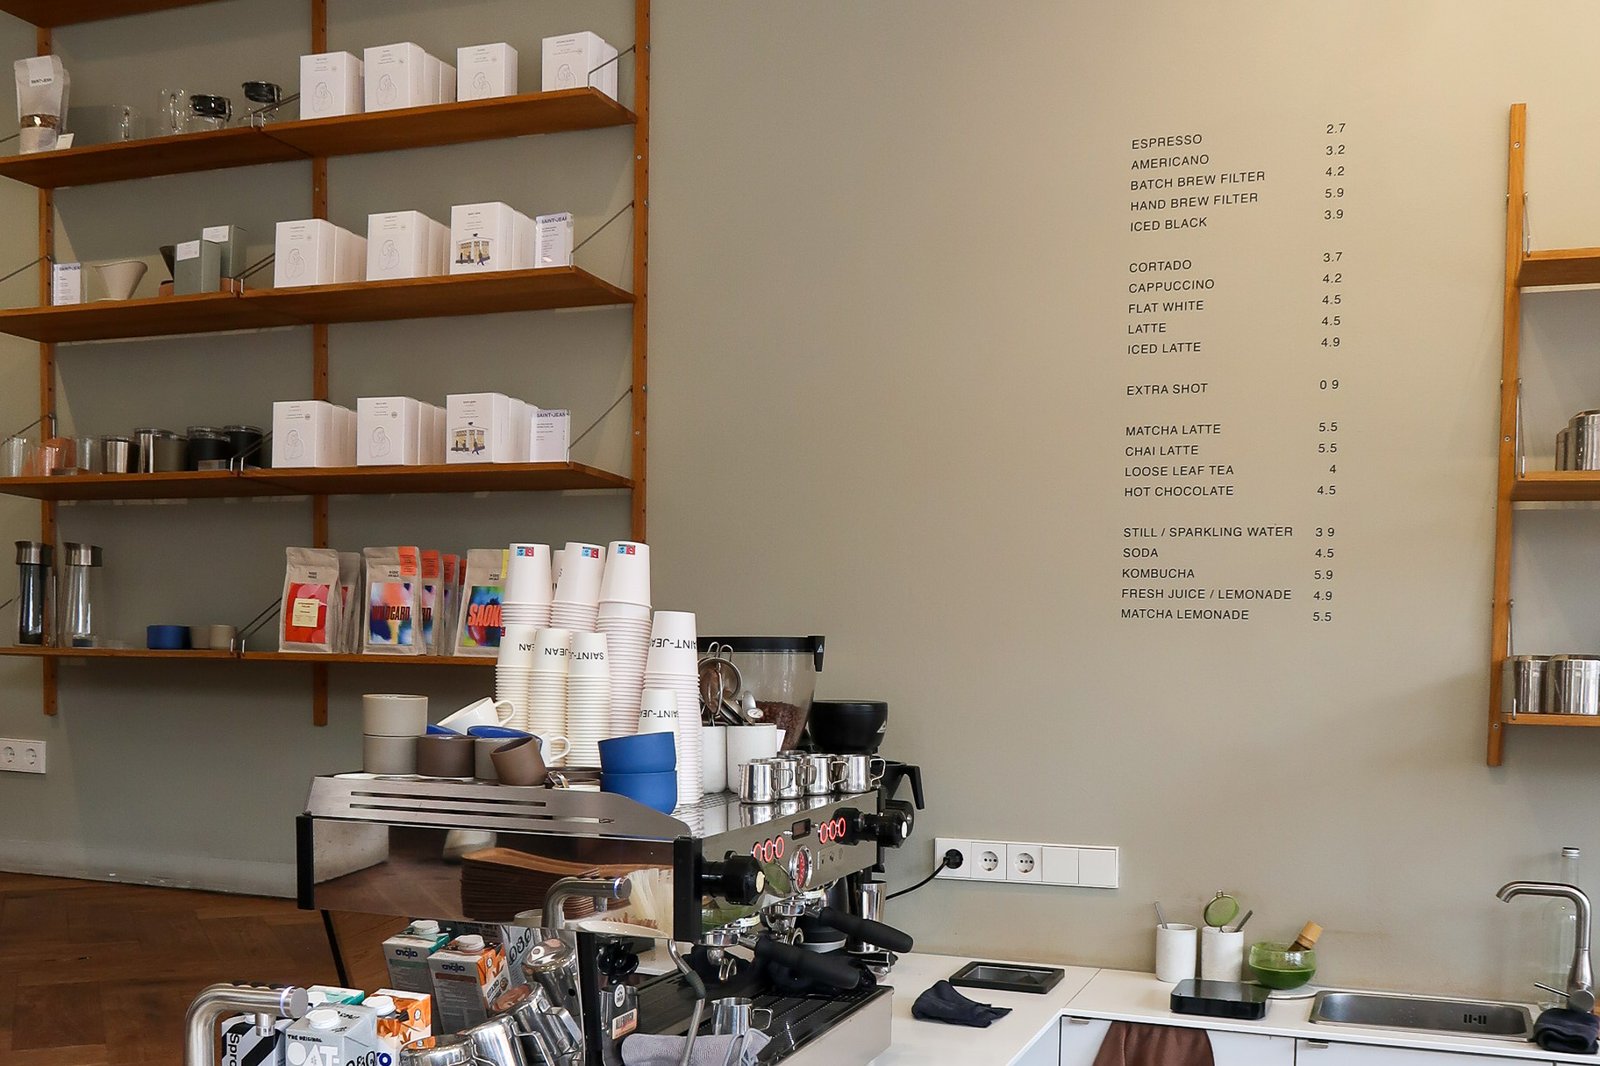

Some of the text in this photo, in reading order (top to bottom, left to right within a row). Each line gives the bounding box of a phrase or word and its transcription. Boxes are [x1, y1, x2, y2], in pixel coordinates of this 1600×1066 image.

[1131, 122, 1347, 150] ESPRESSO 2.7
[1130, 144, 1346, 171] AMERICANO 3.2
[1130, 165, 1345, 191] BATCH BREW FILTER 4.2
[1130, 187, 1345, 212] HAND BREW FILTER 5.9
[1130, 208, 1344, 233] ICED BLACK 3.9
[1129, 251, 1343, 274] CORTADO 3.7
[1128, 272, 1343, 294] CAPPUCCINO 4.2
[1128, 294, 1342, 314] FLAT WHITE 4.5
[1127, 315, 1341, 335] LATTE 4.5
[1127, 336, 1341, 355] ICED LATTE 4.9
[1126, 384, 1169, 396] EXTRA
[1172, 382, 1209, 395] SHOT
[1125, 421, 1338, 437] MATCHA LATTE 5.5
[1124, 442, 1338, 457] CHAI LATTE 5.5
[1124, 464, 1337, 477] LOOSE LEAF TEA 4
[1124, 485, 1337, 498] HOT CHOCOLATE 4.5
[1123, 527, 1158, 538] STILL
[1168, 526, 1243, 538] SPARKLING
[1246, 526, 1293, 537] WATER
[1122, 547, 1335, 559] SODA 4.5
[1122, 568, 1334, 580] KOMBUCHA 5.9
[1121, 588, 1164, 599] FRESH
[1167, 588, 1206, 600] JUICE
[1217, 589, 1292, 600] LEMONADE
[1312, 590, 1333, 601] 4.9
[1120, 608, 1332, 622] MATCHA LEMONADE 5.5
